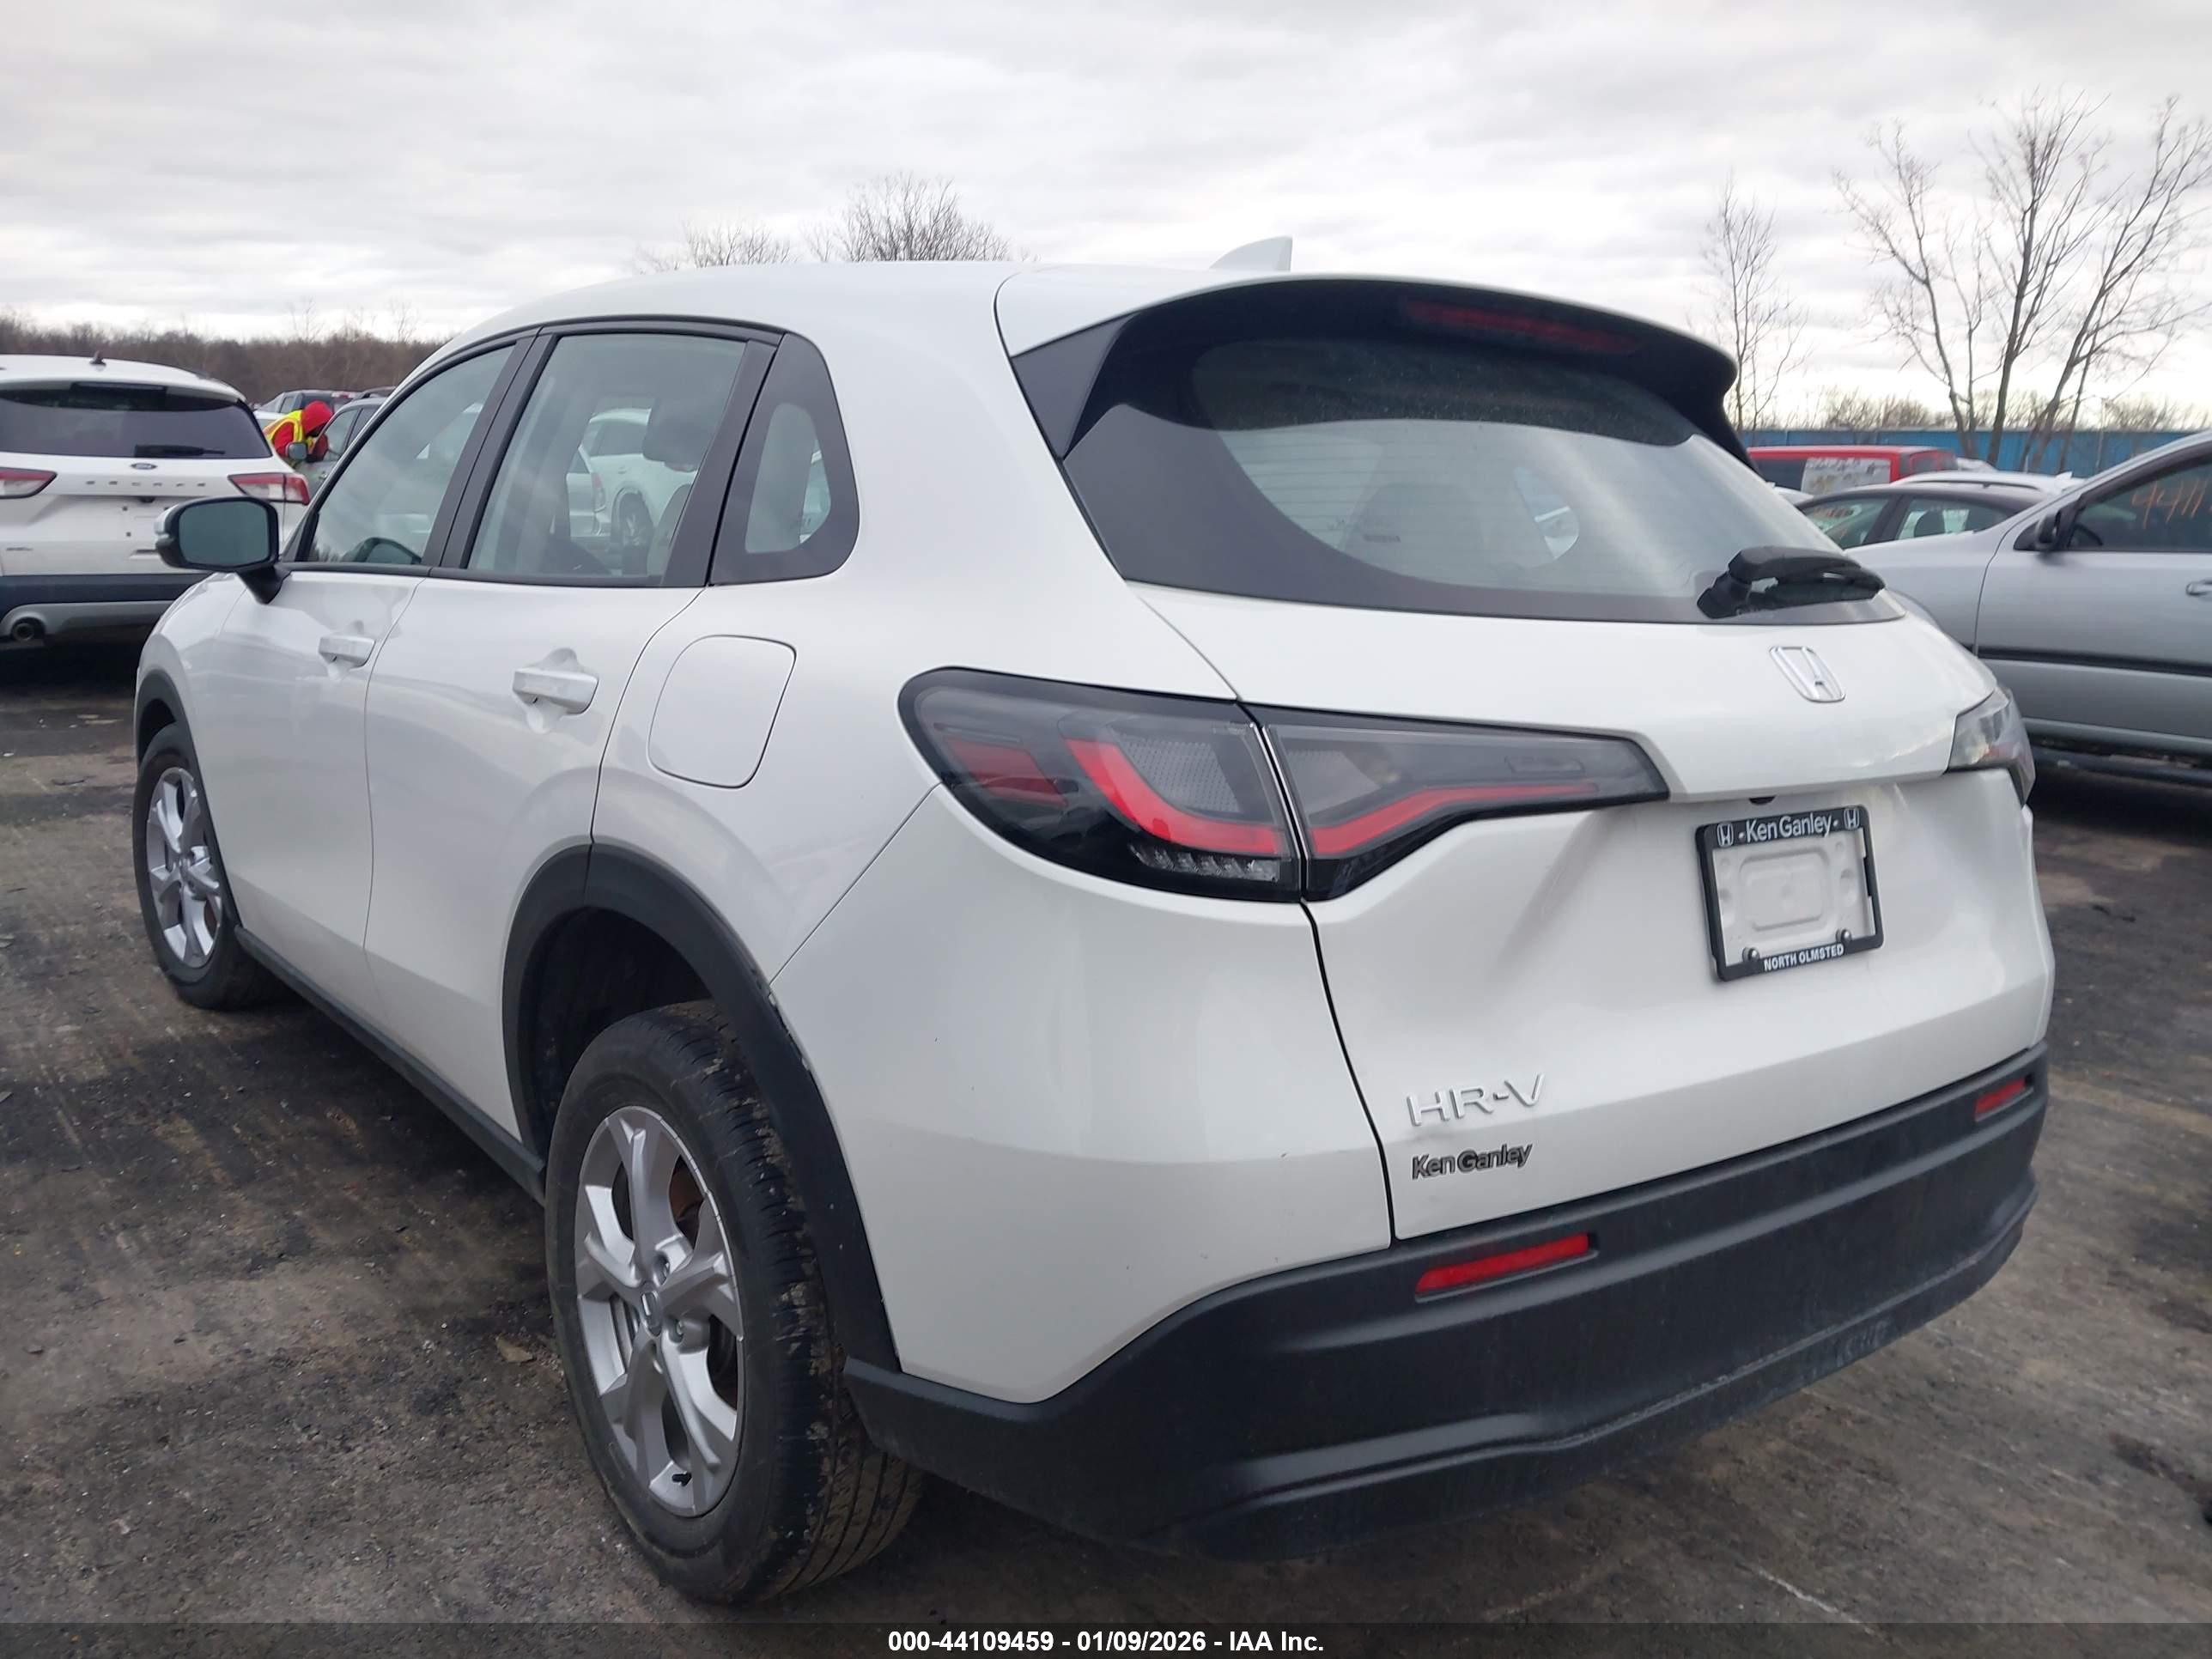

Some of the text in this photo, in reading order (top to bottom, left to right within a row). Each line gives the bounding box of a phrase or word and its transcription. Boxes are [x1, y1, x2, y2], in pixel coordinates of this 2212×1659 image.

[1764, 943, 1844, 971] NORTH OLMSTED
[1407, 1073, 1545, 1127] HR-V
